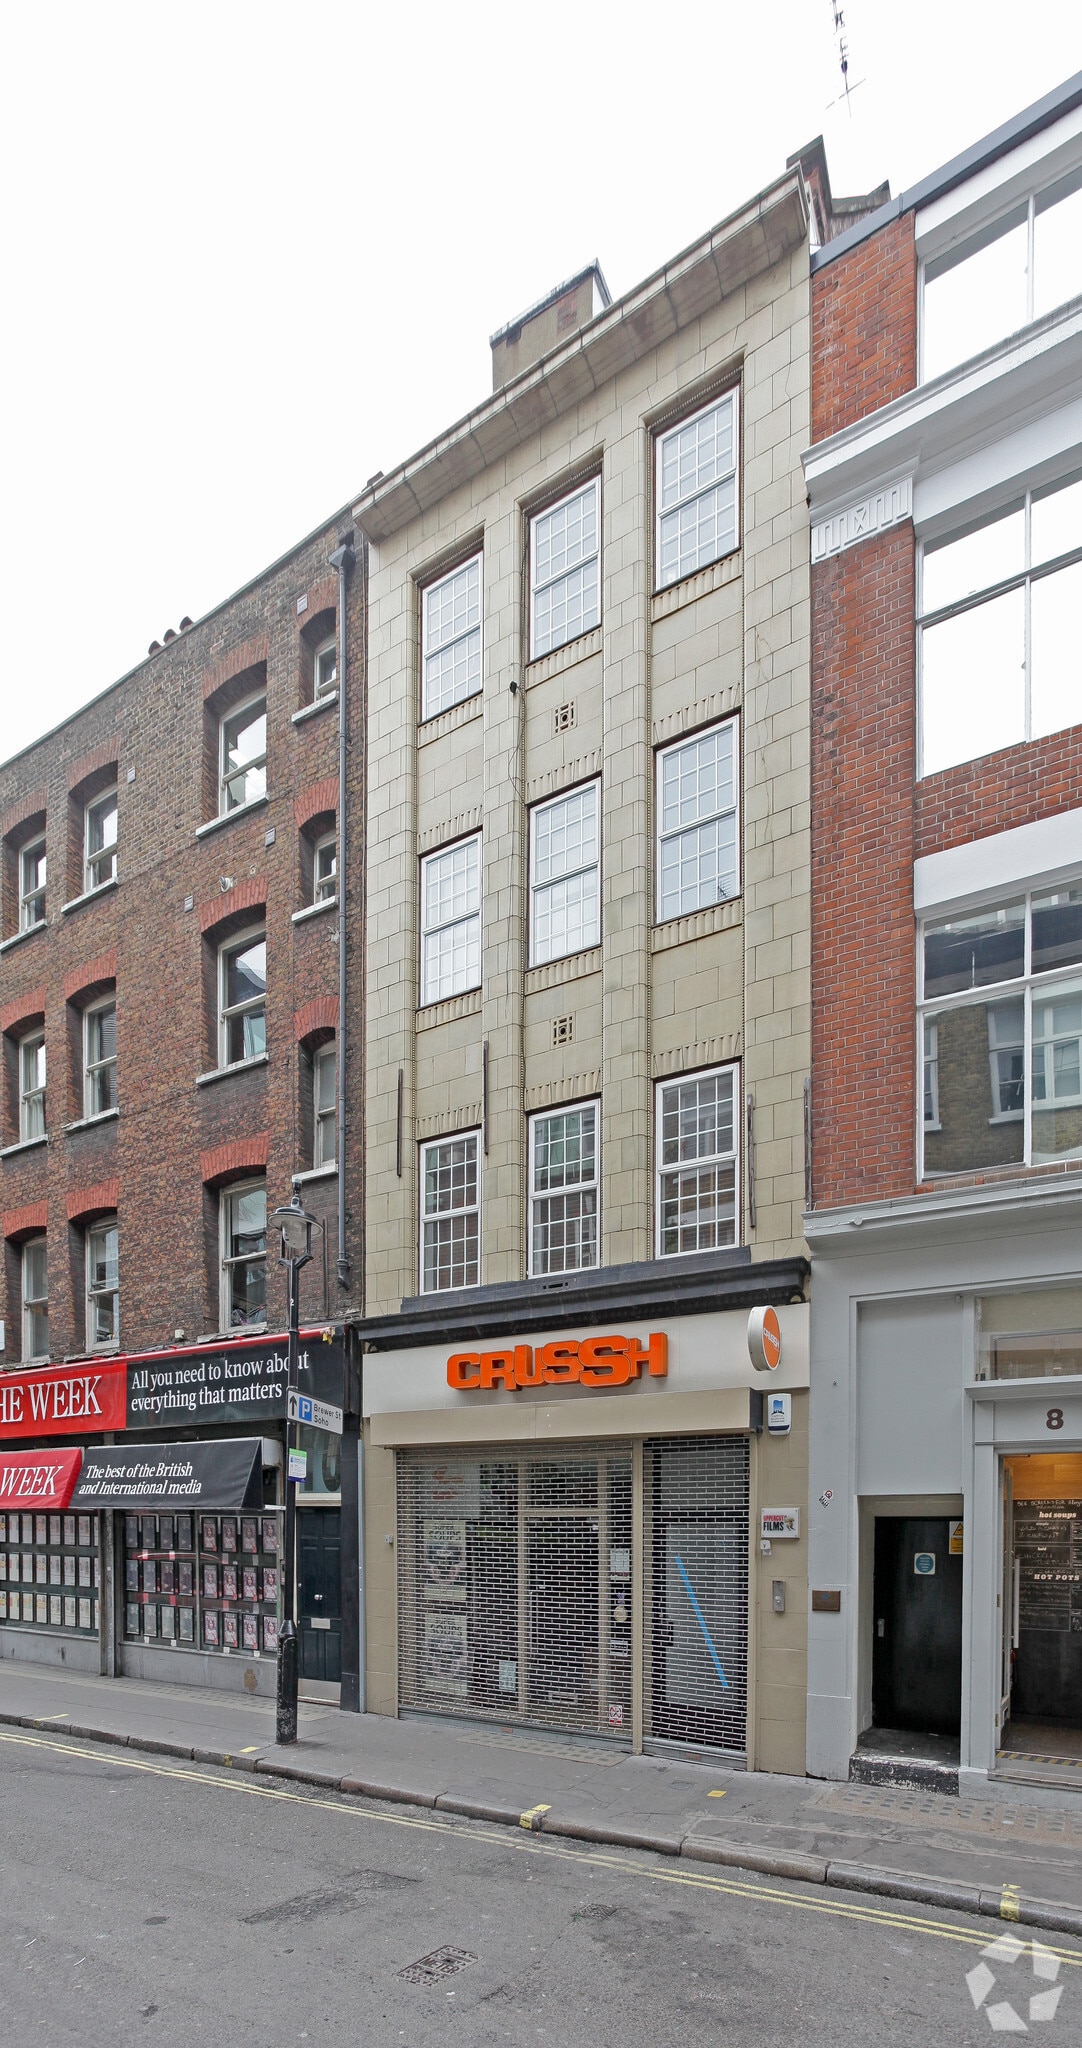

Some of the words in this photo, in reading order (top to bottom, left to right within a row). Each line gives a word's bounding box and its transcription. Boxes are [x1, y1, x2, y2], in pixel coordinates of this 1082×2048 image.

[447, 1332, 668, 1391] CRUSSH
[131, 1370, 149, 1390] All
[150, 1372, 173, 1392] you
[175, 1363, 206, 1384] need
[208, 1364, 221, 1381] to
[224, 1359, 263, 1379] know
[28, 1375, 103, 1422] WEEK
[131, 1390, 197, 1413] everything
[199, 1386, 225, 1405] that
[228, 1383, 282, 1402] matters
[302, 1401, 311, 1418] P
[313, 1403, 334, 1418] Brewer
[335, 1412, 341, 1420] St
[313, 1415, 329, 1426] Soho
[1046, 1408, 1064, 1430] 8
[0, 1466, 63, 1496] WEEK
[86, 1465, 104, 1479] The
[105, 1464, 126, 1478] best
[127, 1463, 141, 1478] of
[140, 1463, 156, 1477] the
[156, 1462, 193, 1477] British
[79, 1481, 100, 1495] and
[99, 1480, 167, 1495] International
[168, 1481, 202, 1494] media
[763, 1522, 784, 1531] FILMS
